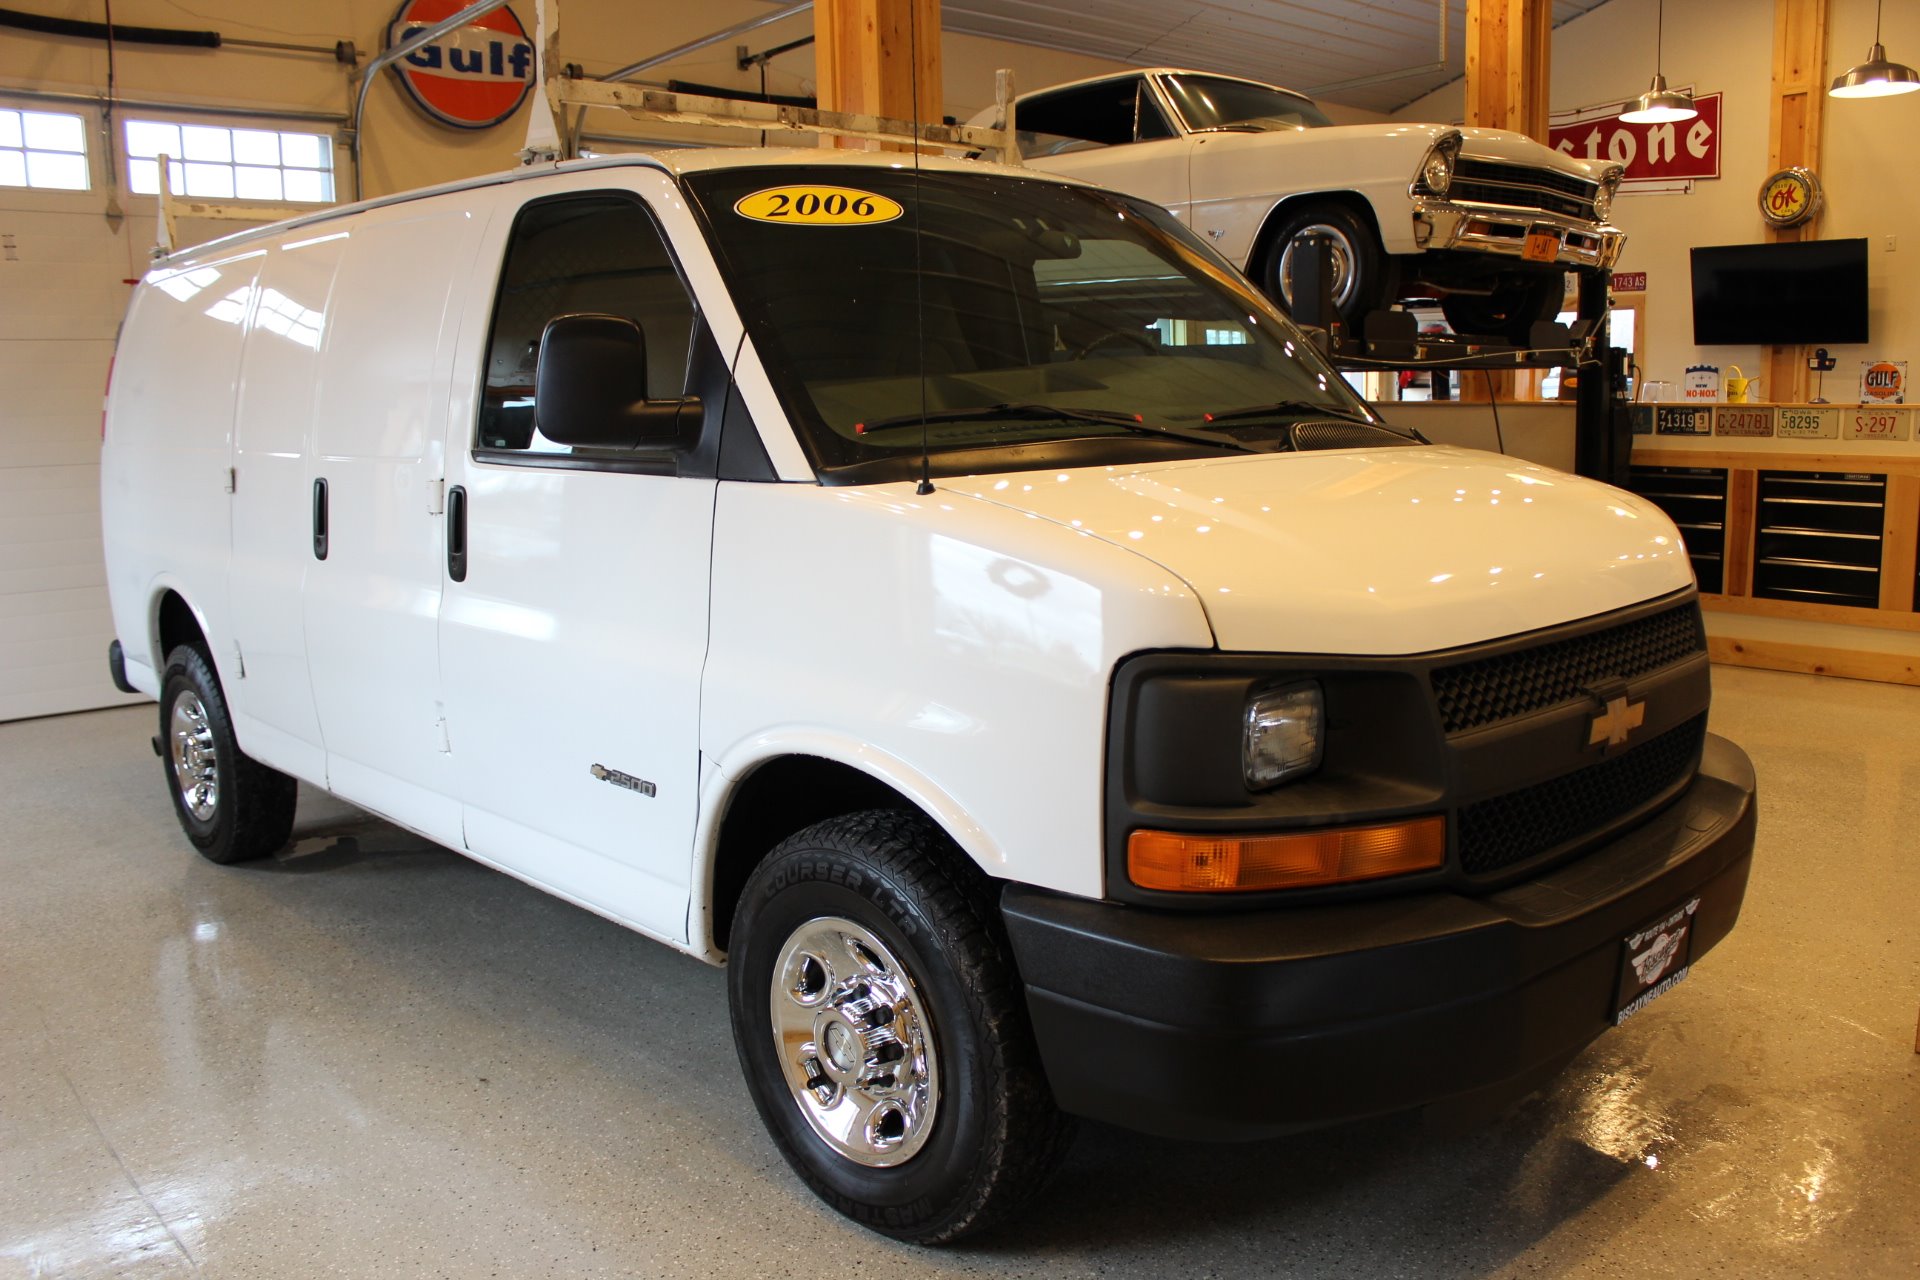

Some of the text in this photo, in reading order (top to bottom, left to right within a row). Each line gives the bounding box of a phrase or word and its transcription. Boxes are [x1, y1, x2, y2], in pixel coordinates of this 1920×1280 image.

[402, 27, 531, 78] Gulf
[766, 194, 875, 217] 2006
[1772, 183, 1799, 210] OK
[1613, 276, 1645, 288] 1743 AS
[1867, 370, 1899, 387] GULF
[1686, 390, 1716, 398] NO-NOX
[1667, 414, 1694, 427] 1319
[1789, 415, 1820, 429] 8295
[610, 770, 656, 798] 2500
[765, 861, 862, 895] COURSER
[1617, 966, 1688, 1025] BISCAYNEAUTO.COM
